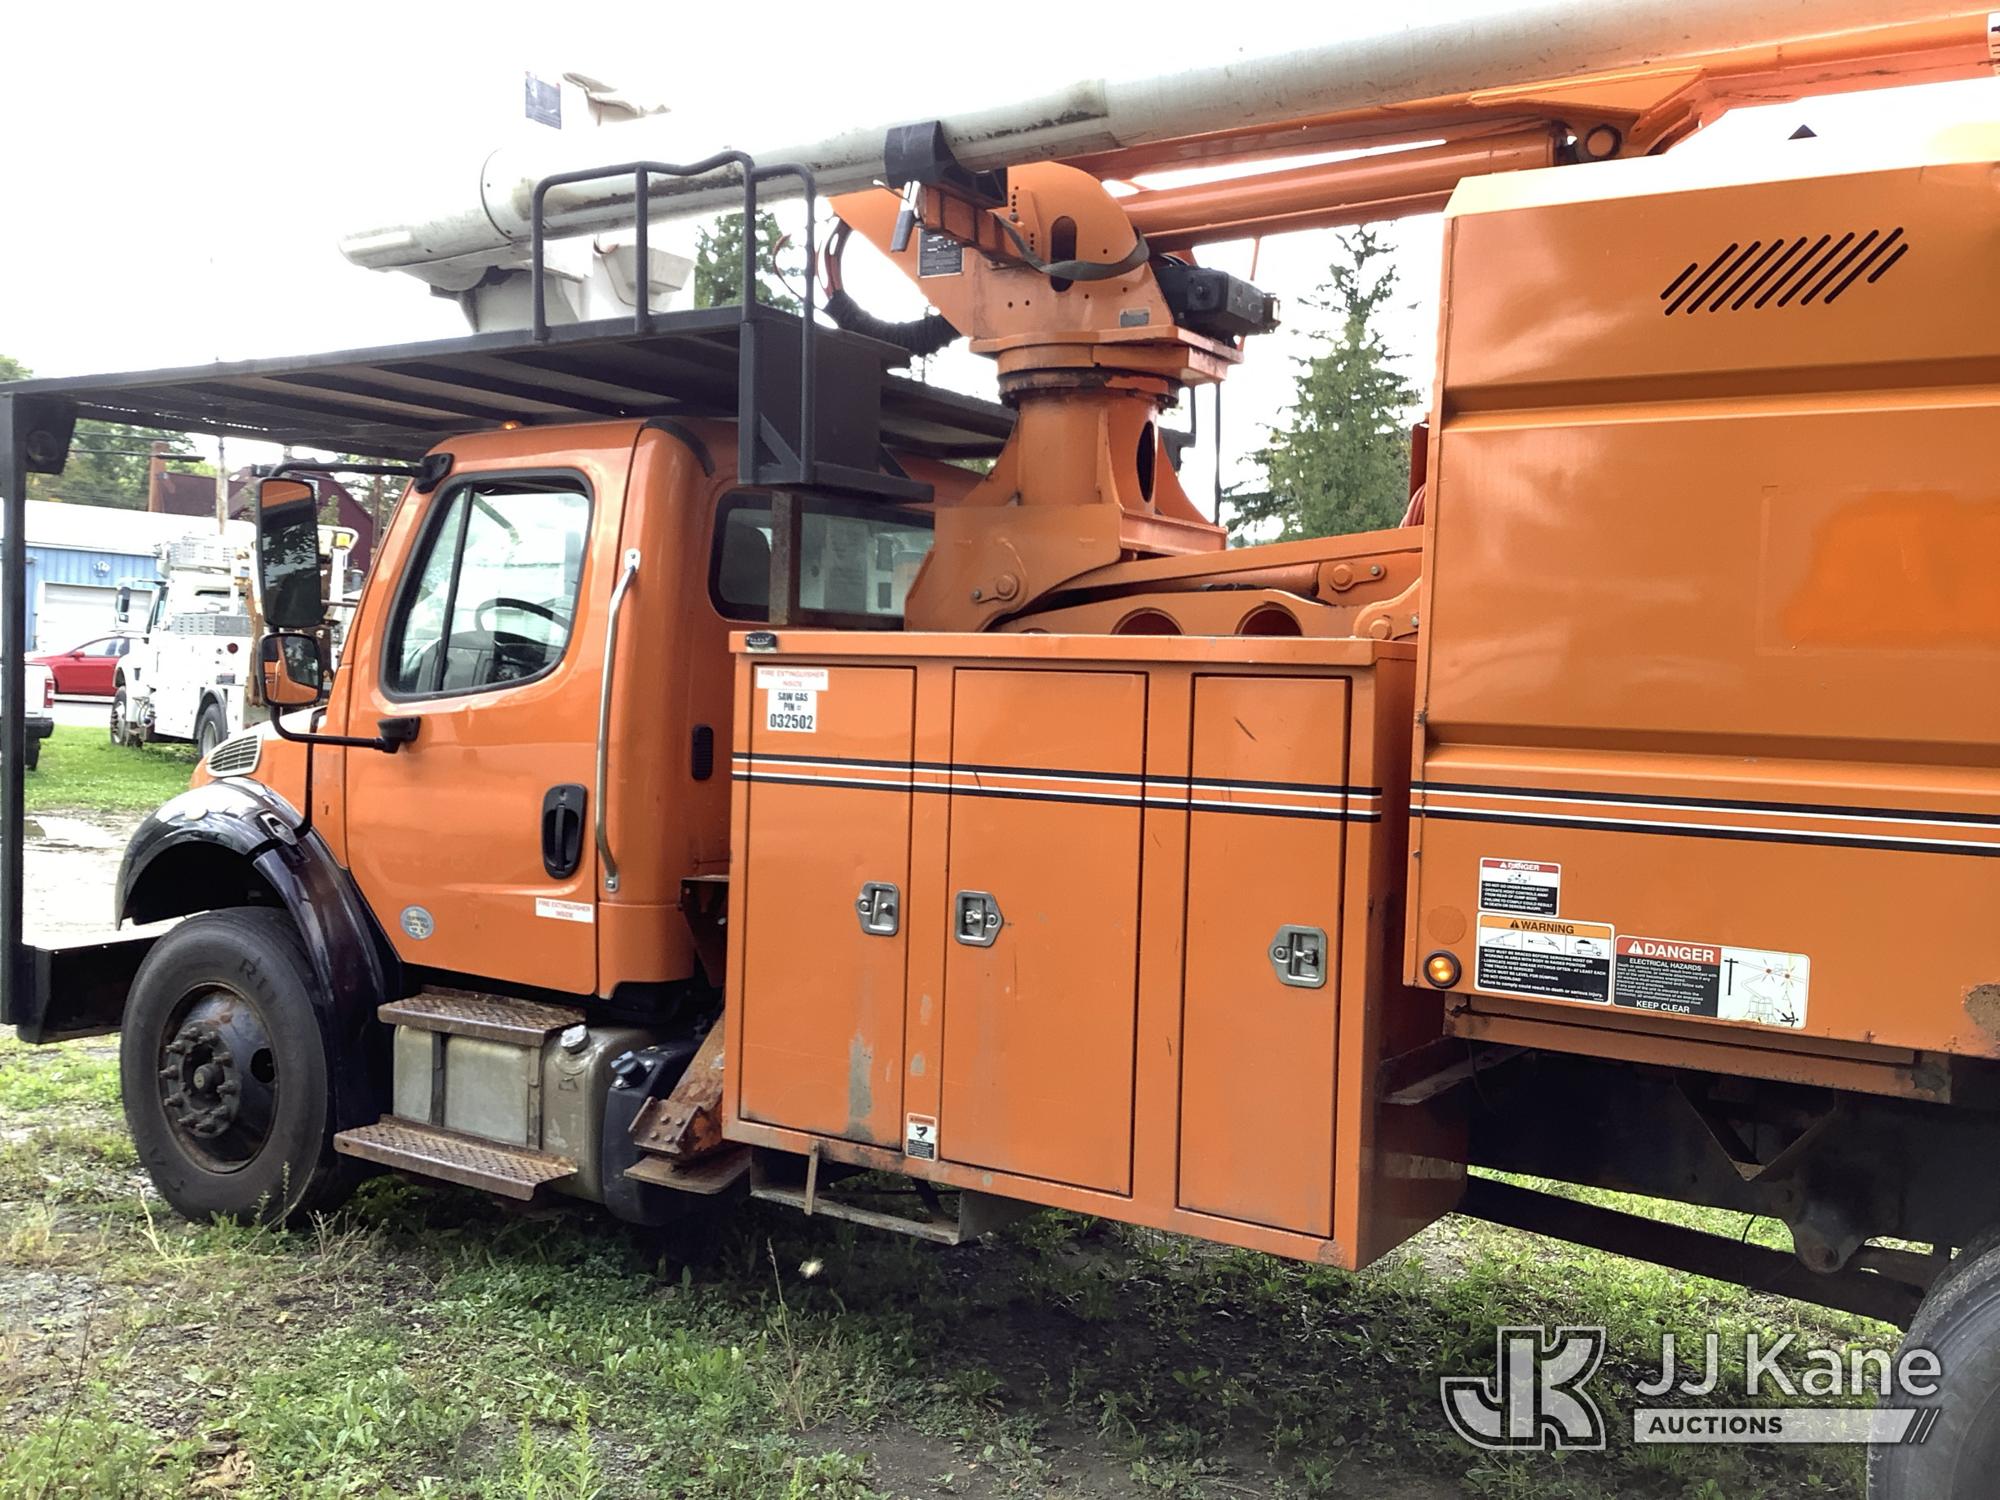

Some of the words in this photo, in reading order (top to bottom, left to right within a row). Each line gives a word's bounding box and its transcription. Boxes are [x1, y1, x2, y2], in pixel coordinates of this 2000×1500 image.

[777, 692, 793, 701] SAW
[795, 692, 808, 702] GAS
[784, 702, 795, 711] PIN
[769, 713, 814, 730] 032502
[1508, 862, 1540, 871] DANGER
[1521, 921, 1574, 934] WARNING
[1645, 943, 1714, 962] DANGER
[1629, 958, 1669, 968] ELECTRICAL
[1670, 963, 1702, 971] HAZARDS
[1636, 1000, 1659, 1009] KEEP
[1661, 1003, 1690, 1014] CLEAR
